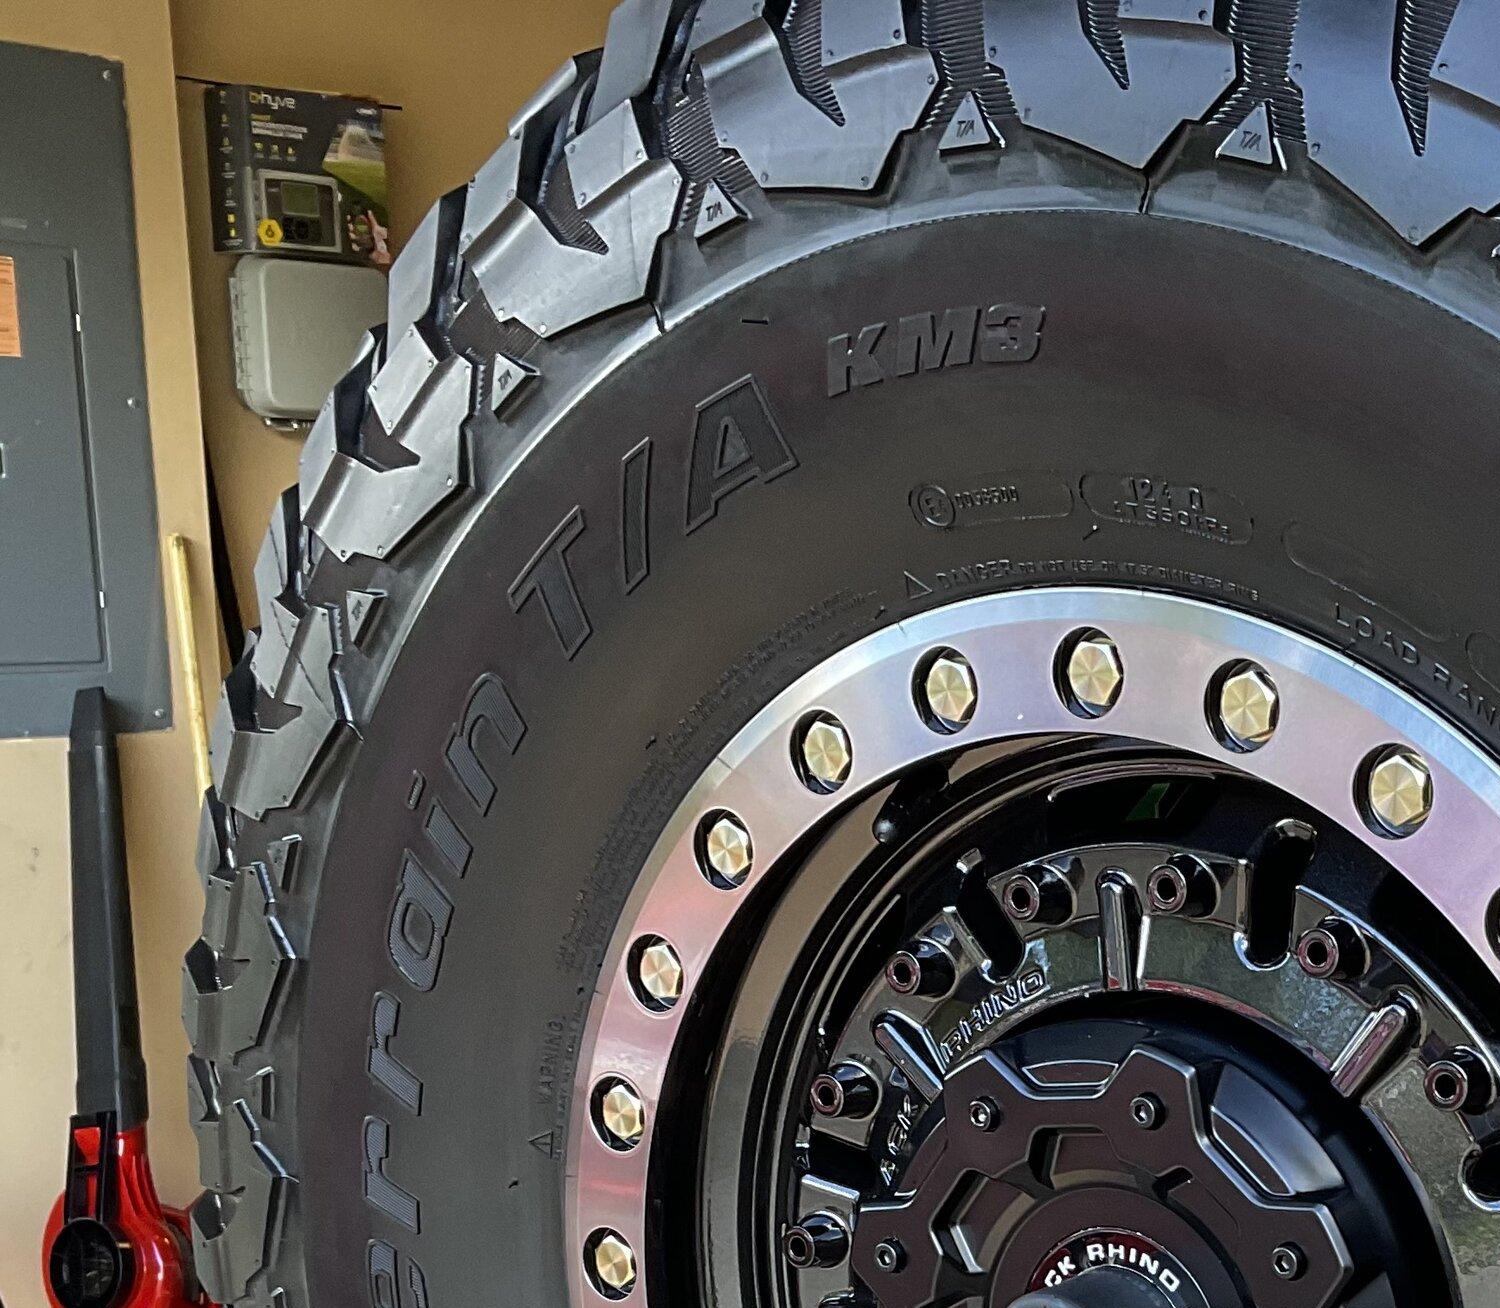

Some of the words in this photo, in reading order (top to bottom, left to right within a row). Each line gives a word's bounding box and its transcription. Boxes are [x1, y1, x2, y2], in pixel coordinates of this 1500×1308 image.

[827, 303, 1047, 398] KM3
[1333, 601, 1420, 666] LOAD
[939, 970, 1050, 1062] RHINO
[1087, 1243, 1180, 1293] RHINO
